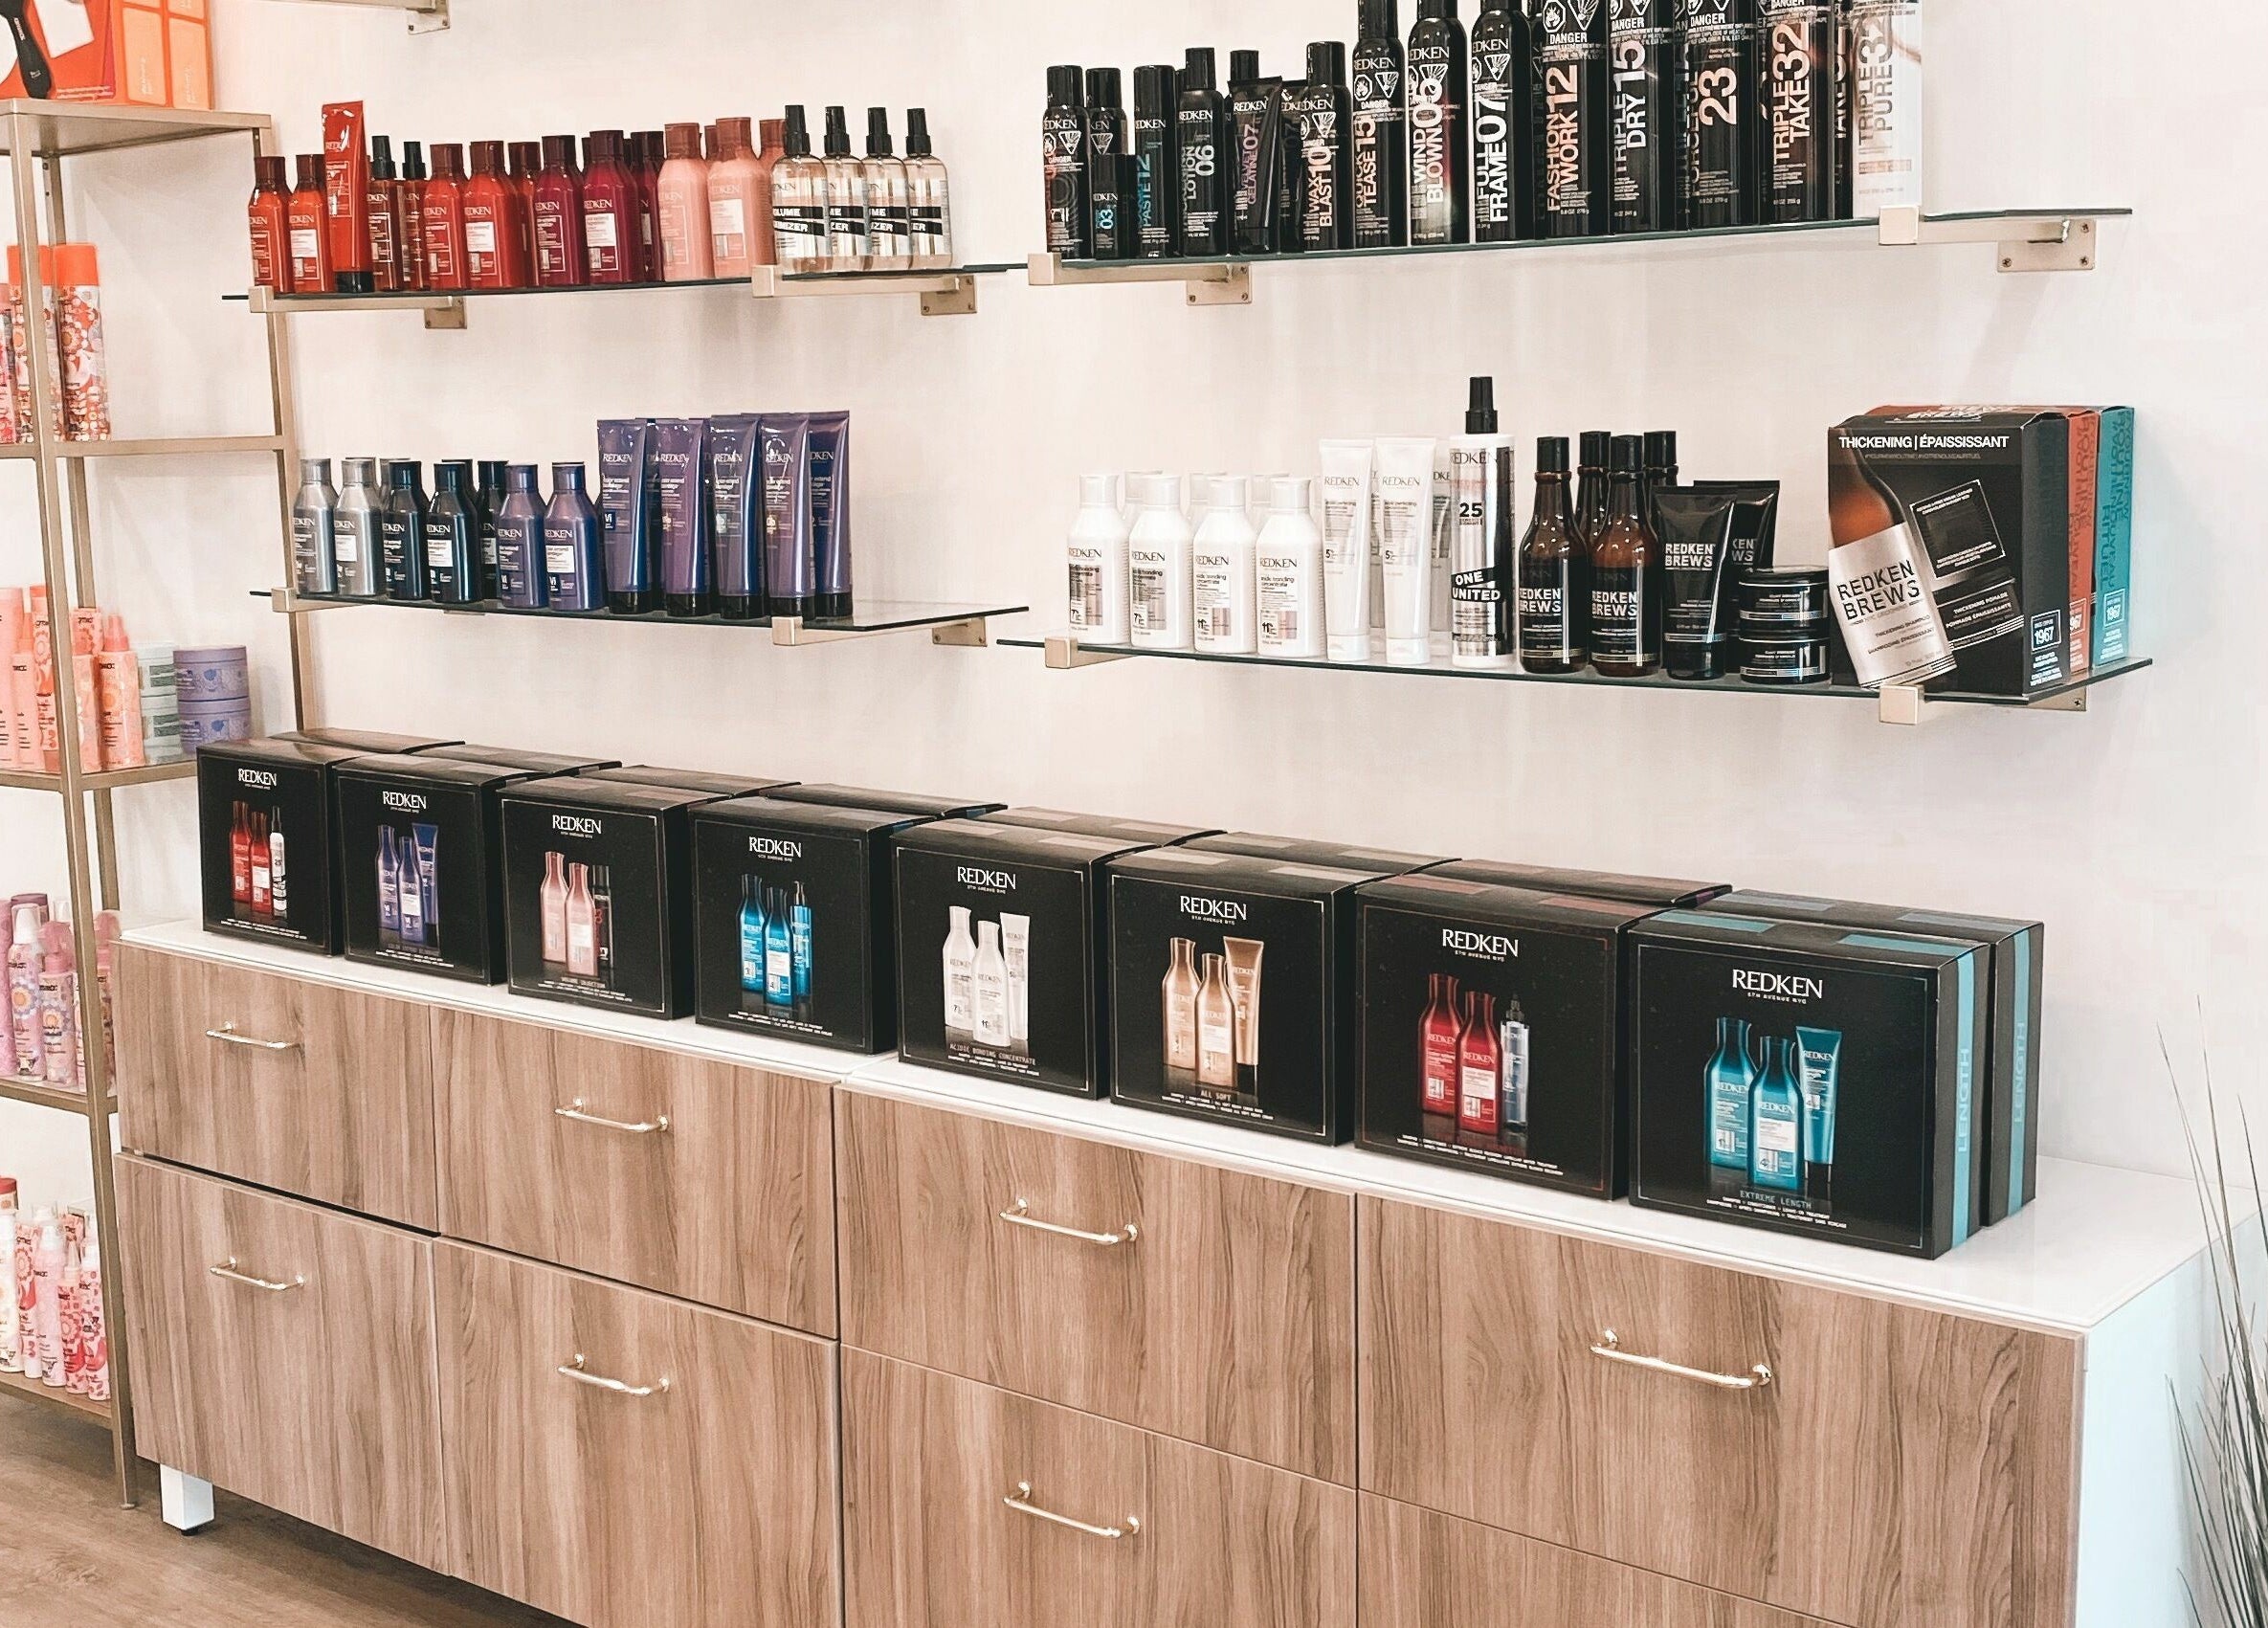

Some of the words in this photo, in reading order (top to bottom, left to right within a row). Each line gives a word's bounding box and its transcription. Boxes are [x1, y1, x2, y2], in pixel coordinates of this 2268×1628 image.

[1612, 17, 1645, 31] DANGER
[1691, 13, 1725, 27] DANGER
[1550, 32, 1588, 45] DANGER
[1772, 22, 1810, 80] 32
[1612, 38, 1646, 91] 15
[1545, 64, 1578, 113] 12
[1699, 67, 1737, 126] 23
[1874, 64, 1893, 131] PURE
[1234, 99, 1267, 112] REDKEN
[1475, 94, 1507, 144] 07
[1789, 77, 1810, 144] TAKE
[1858, 66, 1873, 145] TRIPLE
[1613, 93, 1627, 179] TRIPLE
[1626, 93, 1646, 149] DRY
[1772, 80, 1790, 166] TRIPLE
[1195, 145, 1215, 176] 06
[1413, 128, 1427, 184] WIND
[1545, 112, 1561, 212] FASHION
[1559, 110, 1578, 185] WORK
[1186, 146, 1196, 200] LOTION
[1364, 150, 1377, 206] TEASE
[1426, 126, 1444, 203] BLOWN
[1477, 146, 1490, 198] FULL
[1308, 175, 1321, 213] WAX
[1489, 141, 1508, 222] FRAME
[1319, 176, 1333, 227] BLAST
[1100, 208, 1115, 230] 03
[810, 451, 834, 460] DKEN
[1838, 435, 1913, 449] THICKENING
[1919, 433, 2010, 449] ÉPAISSISSANT
[603, 453, 633, 463] REDKEN
[660, 453, 687, 463] REDKEN
[1324, 477, 1360, 486] REDKEN
[1383, 476, 1420, 486] REDKEN
[1459, 502, 1483, 518] 25
[1665, 543, 1714, 555] REDKEN
[1732, 538, 1754, 549] KEN
[1664, 555, 1713, 568] BREWS
[1456, 570, 1484, 586] ONE
[1837, 559, 1914, 600] REDKEN
[1452, 588, 1501, 601] UNITED
[1843, 579, 1920, 620] BREWS
[2035, 625, 2055, 645] 1967
[238, 769, 278, 786] REDKEN
[382, 791, 427, 810] REDKEN
[552, 814, 602, 835] REDKEN
[748, 836, 802, 858] REDKEN
[957, 866, 1016, 890] REDKEN
[1180, 895, 1247, 920] REDKEN
[1442, 928, 1519, 958] REDKEN
[1732, 969, 1823, 999] REDKEN
[1957, 1048, 1969, 1152] LENGTH
[1740, 1190, 1775, 1204] EXTREME
[1780, 1197, 1812, 1210] LENGTH
